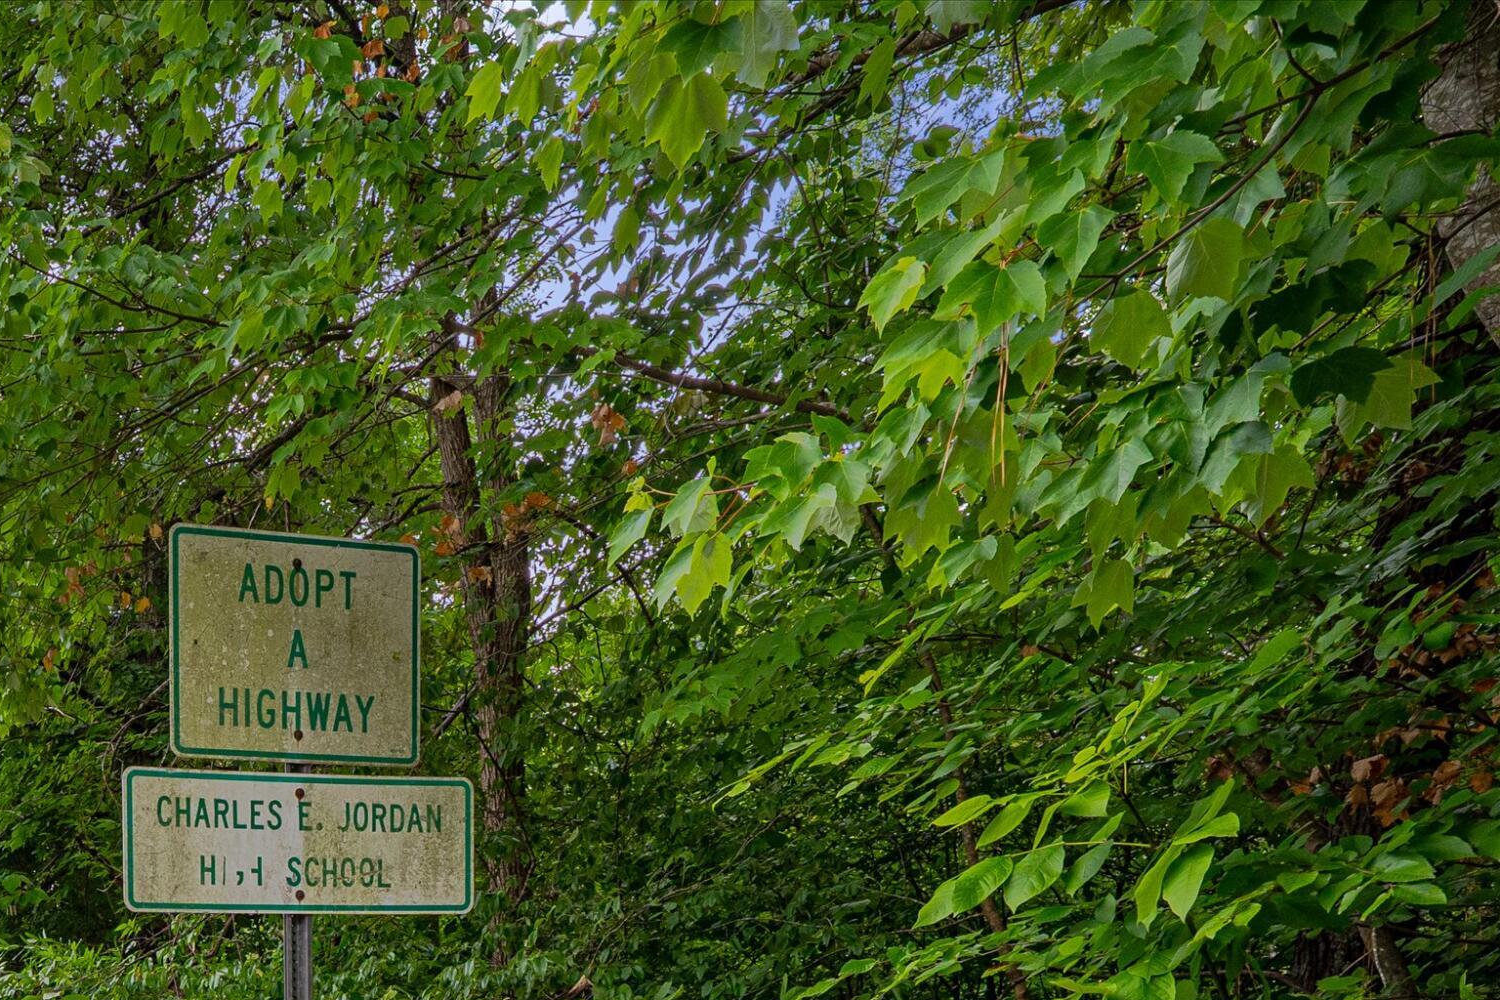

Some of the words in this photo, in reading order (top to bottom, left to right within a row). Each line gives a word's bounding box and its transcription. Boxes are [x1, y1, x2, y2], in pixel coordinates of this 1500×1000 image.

[238, 563, 357, 610] ADOPT
[287, 629, 309, 669] A
[218, 686, 376, 733] HIGHWAY
[156, 795, 283, 831] CHARLES
[298, 801, 324, 831] E.
[338, 801, 442, 833] JORDAN
[286, 856, 392, 889] SCHOOL
